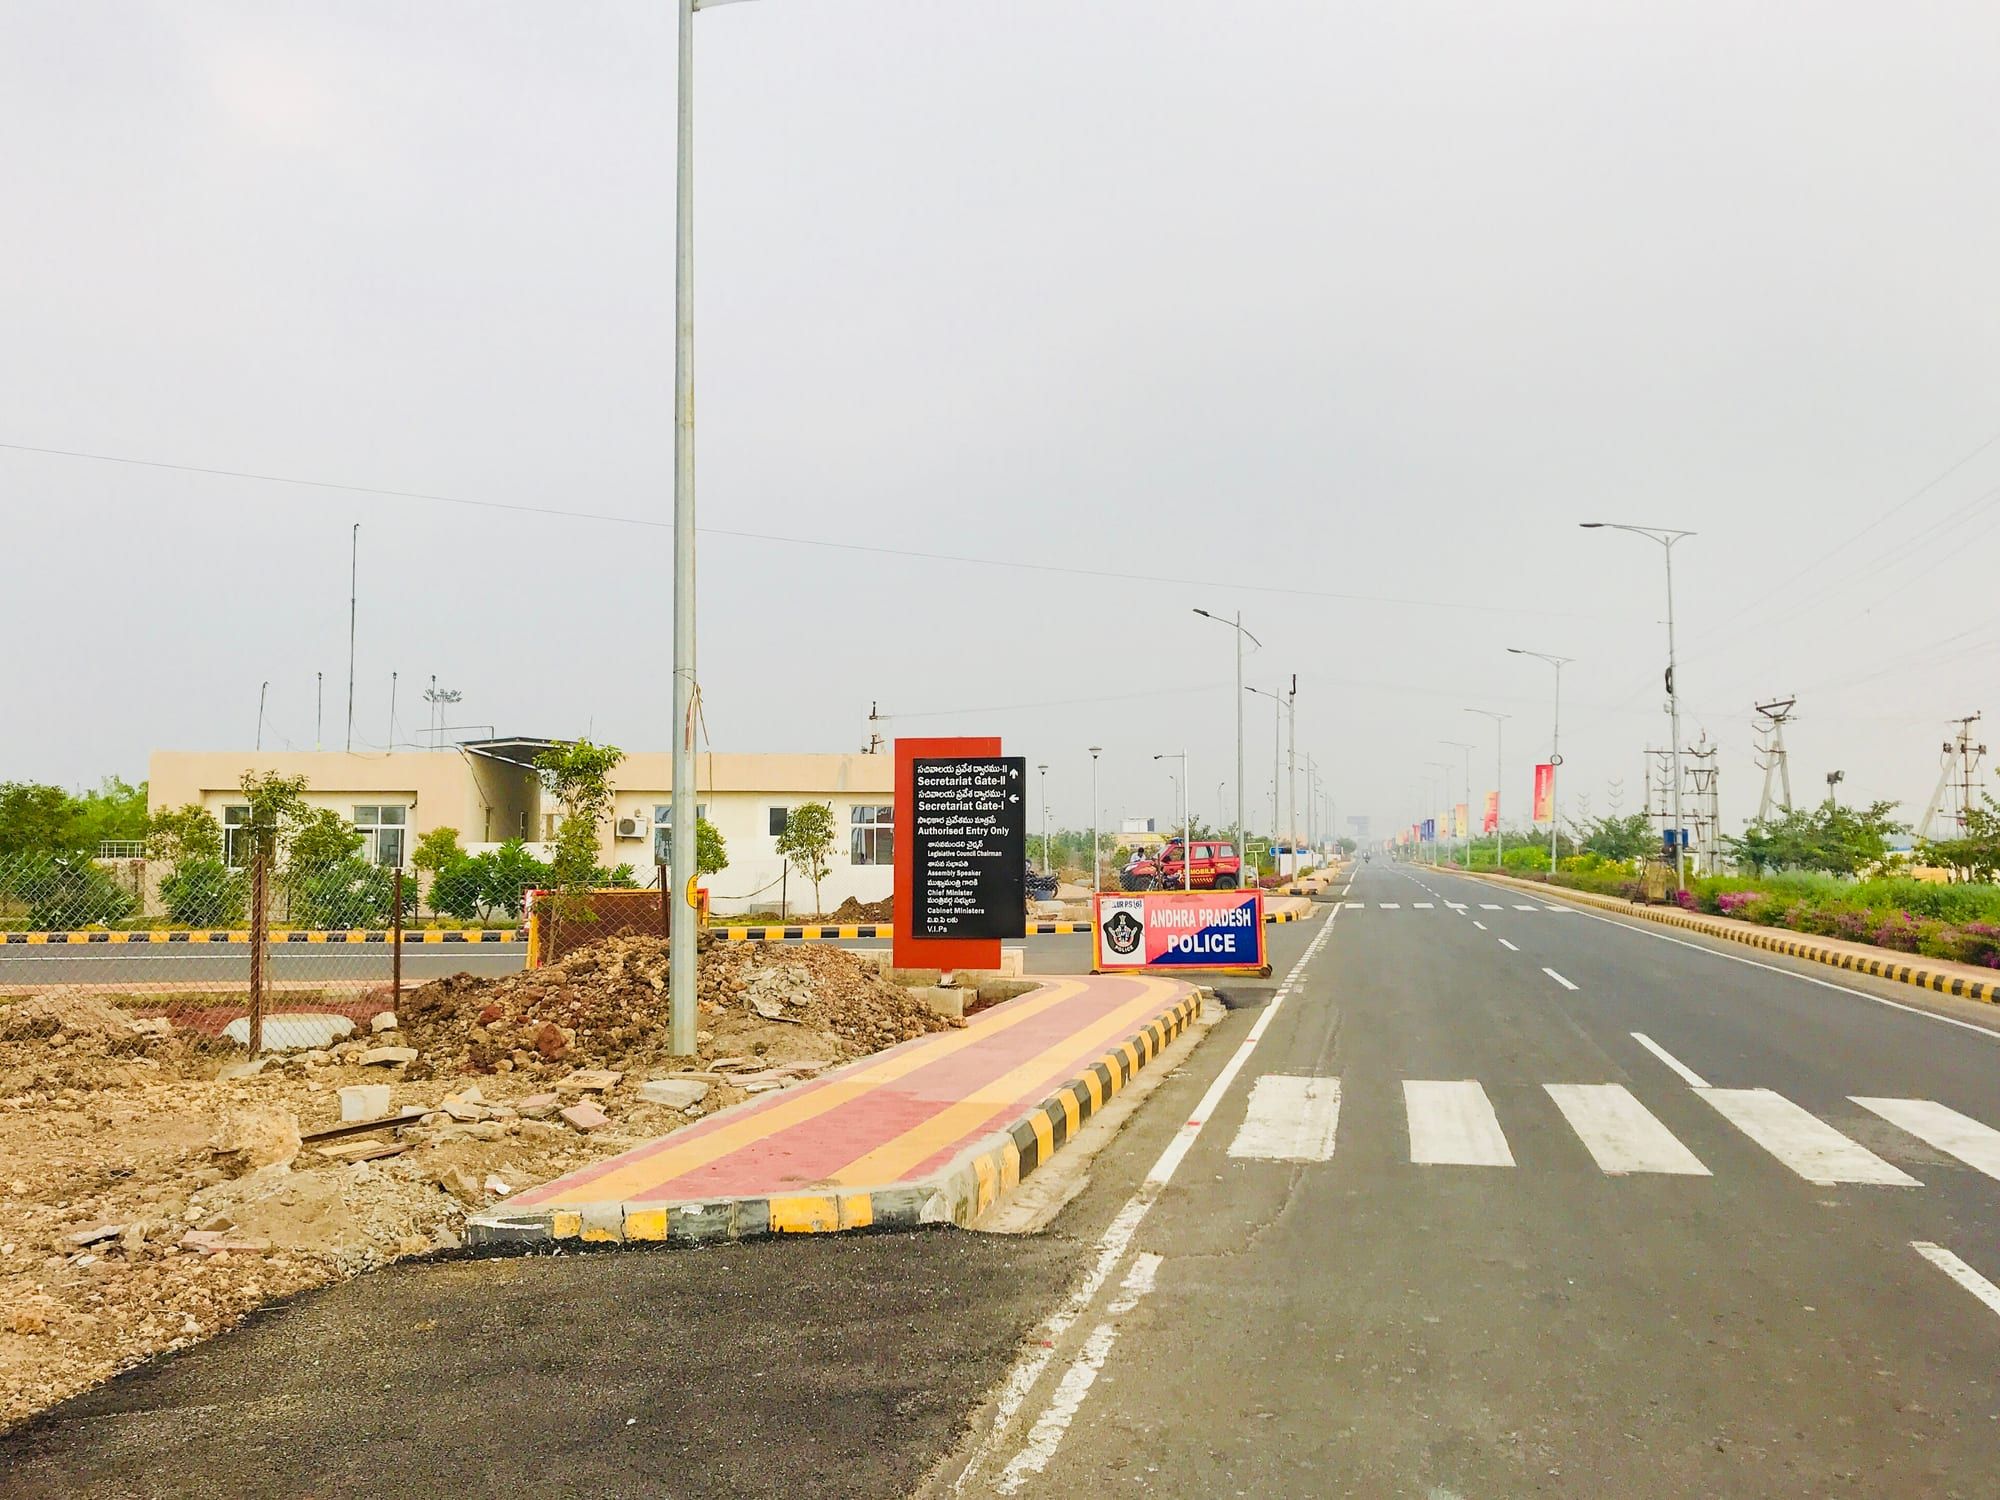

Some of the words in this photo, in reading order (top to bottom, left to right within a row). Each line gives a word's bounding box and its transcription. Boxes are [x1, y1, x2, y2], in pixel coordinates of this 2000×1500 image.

[918, 776, 972, 786] Secretariat
[974, 775, 1006, 786] Gate-II
[918, 801, 973, 811] Secretariat
[975, 801, 1004, 811] Gate-I
[917, 826, 964, 835] Authorised
[966, 827, 988, 836] Entry
[990, 826, 1009, 836] Only
[927, 850, 955, 858] Legislative
[927, 870, 955, 878] Assembly
[956, 870, 981, 878] Speaker
[1150, 909, 1196, 928] ANDHRA
[1200, 908, 1251, 927] PRADESH
[1167, 934, 1236, 953] POLICE
